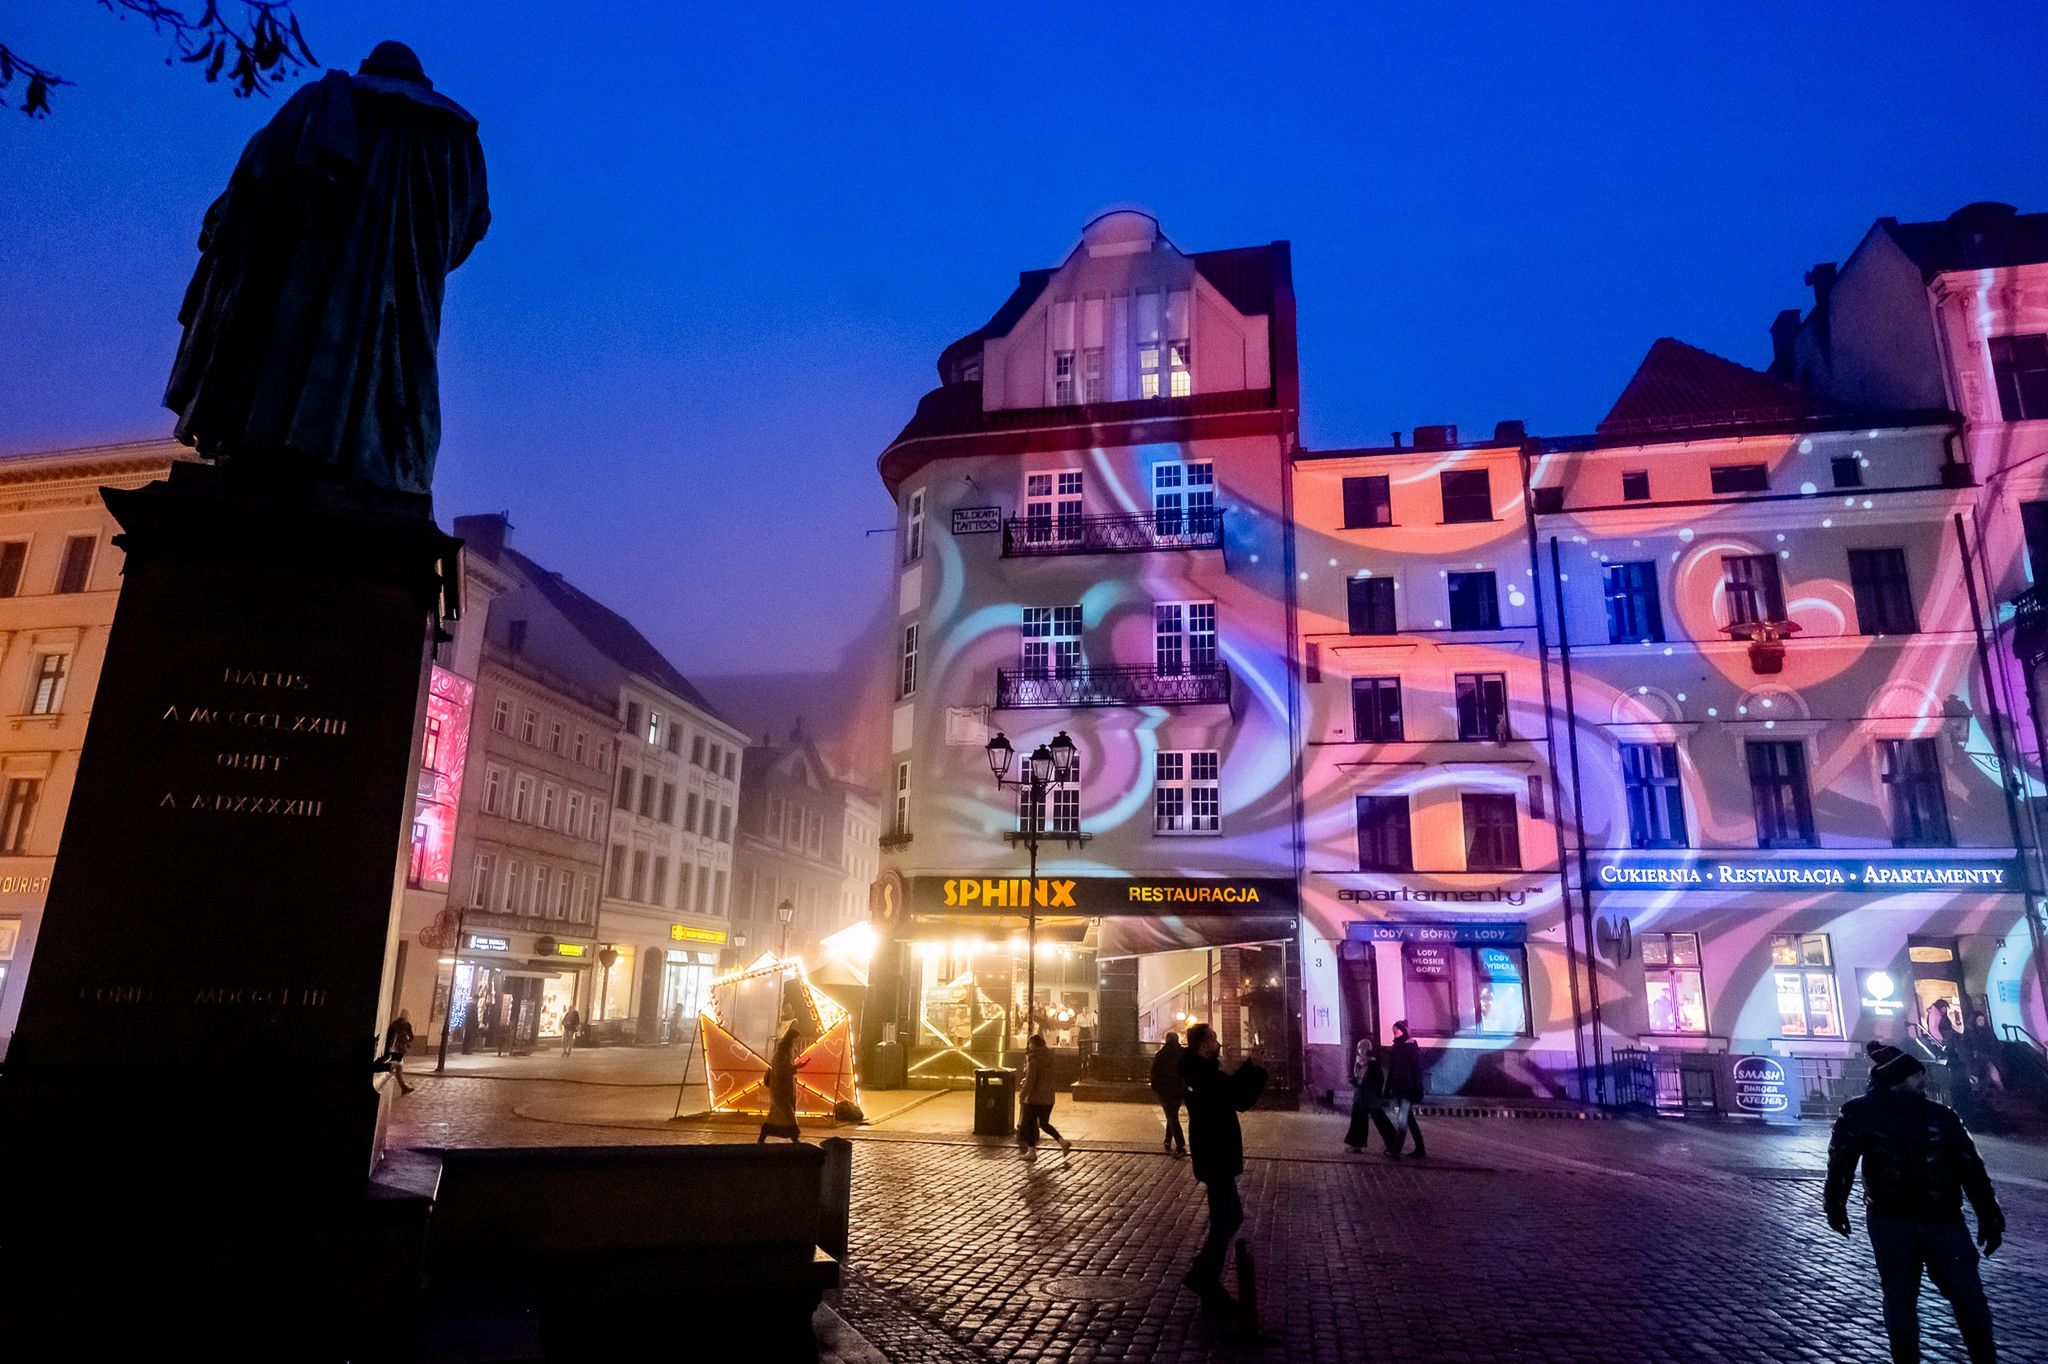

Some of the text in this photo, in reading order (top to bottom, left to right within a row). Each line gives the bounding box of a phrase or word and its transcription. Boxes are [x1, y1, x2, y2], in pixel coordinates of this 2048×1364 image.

[955, 510, 998, 520] TILL DEATH
[955, 519, 998, 531] TATTOO
[223, 667, 310, 689] NATUS
[1601, 865, 2004, 885] CUKIERNIA RESTAURACJA APARTAMENTY
[0, 876, 49, 894] OURIST
[943, 878, 1077, 909] SPHINX
[1129, 886, 1260, 904] RESTAURACJA
[1337, 886, 1526, 906] apartamenty
[1373, 929, 1404, 939] LODY
[1475, 930, 1505, 940] LODY
[1417, 949, 1438, 957] LODY
[1489, 954, 1510, 962] LODY
[1315, 957, 1322, 968] 3
[1416, 966, 1441, 974] GOFRY
[1738, 1069, 1780, 1080] SMASH
[1743, 1084, 1778, 1093] BURGER
[1742, 1096, 1783, 1105] ATELIER
